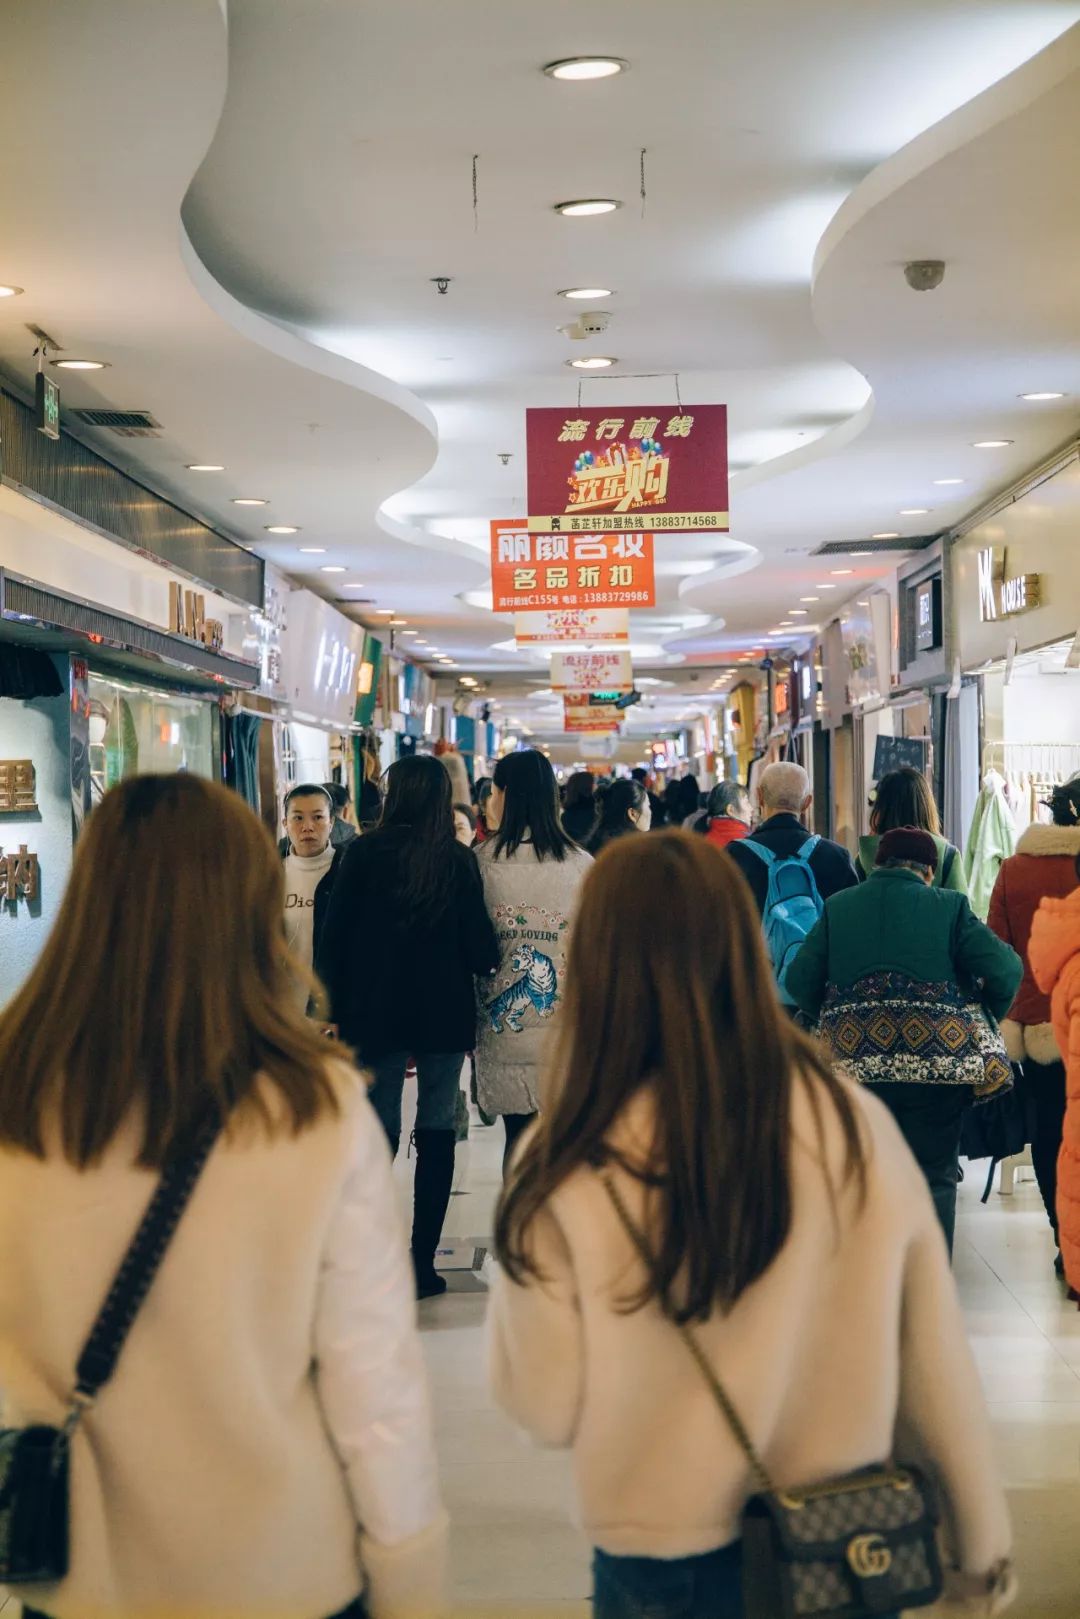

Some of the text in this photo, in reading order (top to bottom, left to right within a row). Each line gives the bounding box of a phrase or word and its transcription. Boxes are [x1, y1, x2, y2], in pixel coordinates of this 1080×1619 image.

[557, 415, 694, 442] 流行前线
[565, 456, 670, 513] 欢乐购
[650, 515, 718, 527] 13883714568
[513, 564, 634, 590] 名品折扣
[1000, 574, 1027, 615] HOUSE
[285, 893, 315, 909] Dio
[498, 929, 559, 942] EEP LOVING
